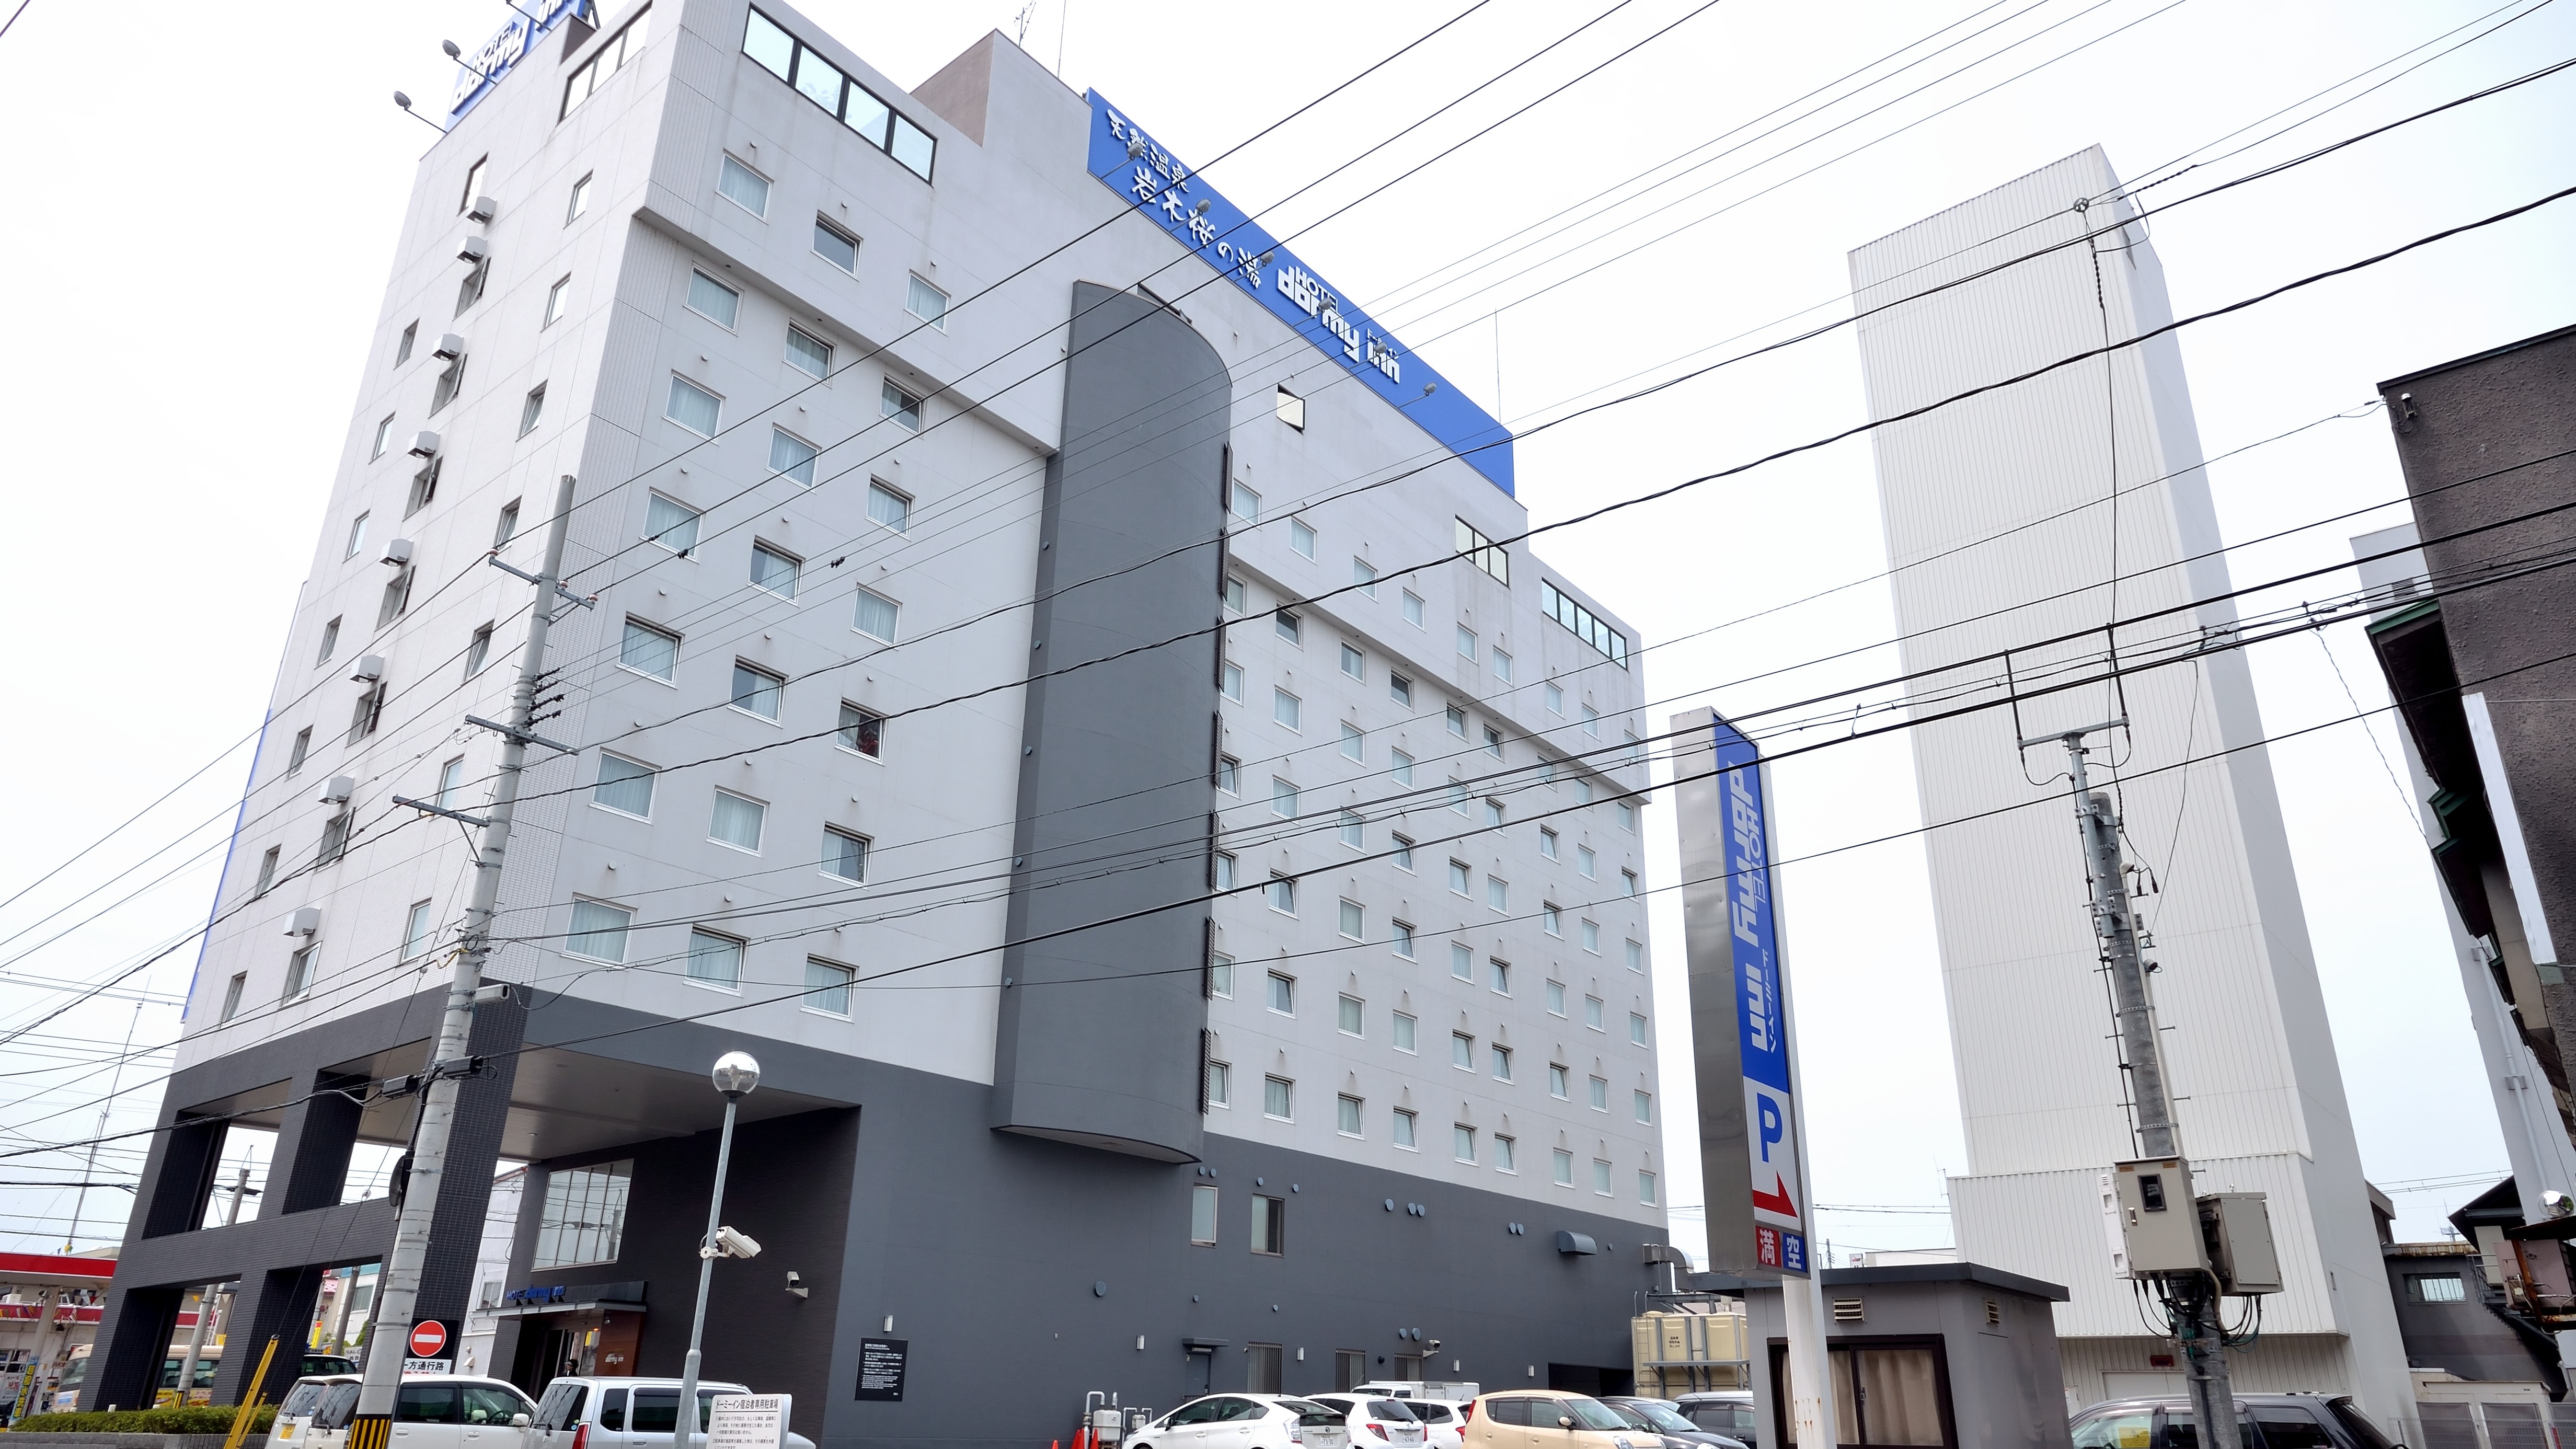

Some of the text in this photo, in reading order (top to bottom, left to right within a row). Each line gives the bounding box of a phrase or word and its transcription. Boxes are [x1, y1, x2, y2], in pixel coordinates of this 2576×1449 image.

[1107, 109, 1190, 192] 天然温泉
[1278, 265, 1360, 363] dormy
[1295, 266, 1339, 313] HOTEL
[1728, 761, 1759, 948] dormy
[1746, 807, 1766, 912] HOTEL
[1762, 948, 1777, 1053] ドーミーイン
[1757, 1092, 1783, 1163] P
[1759, 1228, 1776, 1266] 満
[1786, 1235, 1802, 1270] 空
[716, 1399, 778, 1410] ドーミーイン宿泊者専用駐車場
